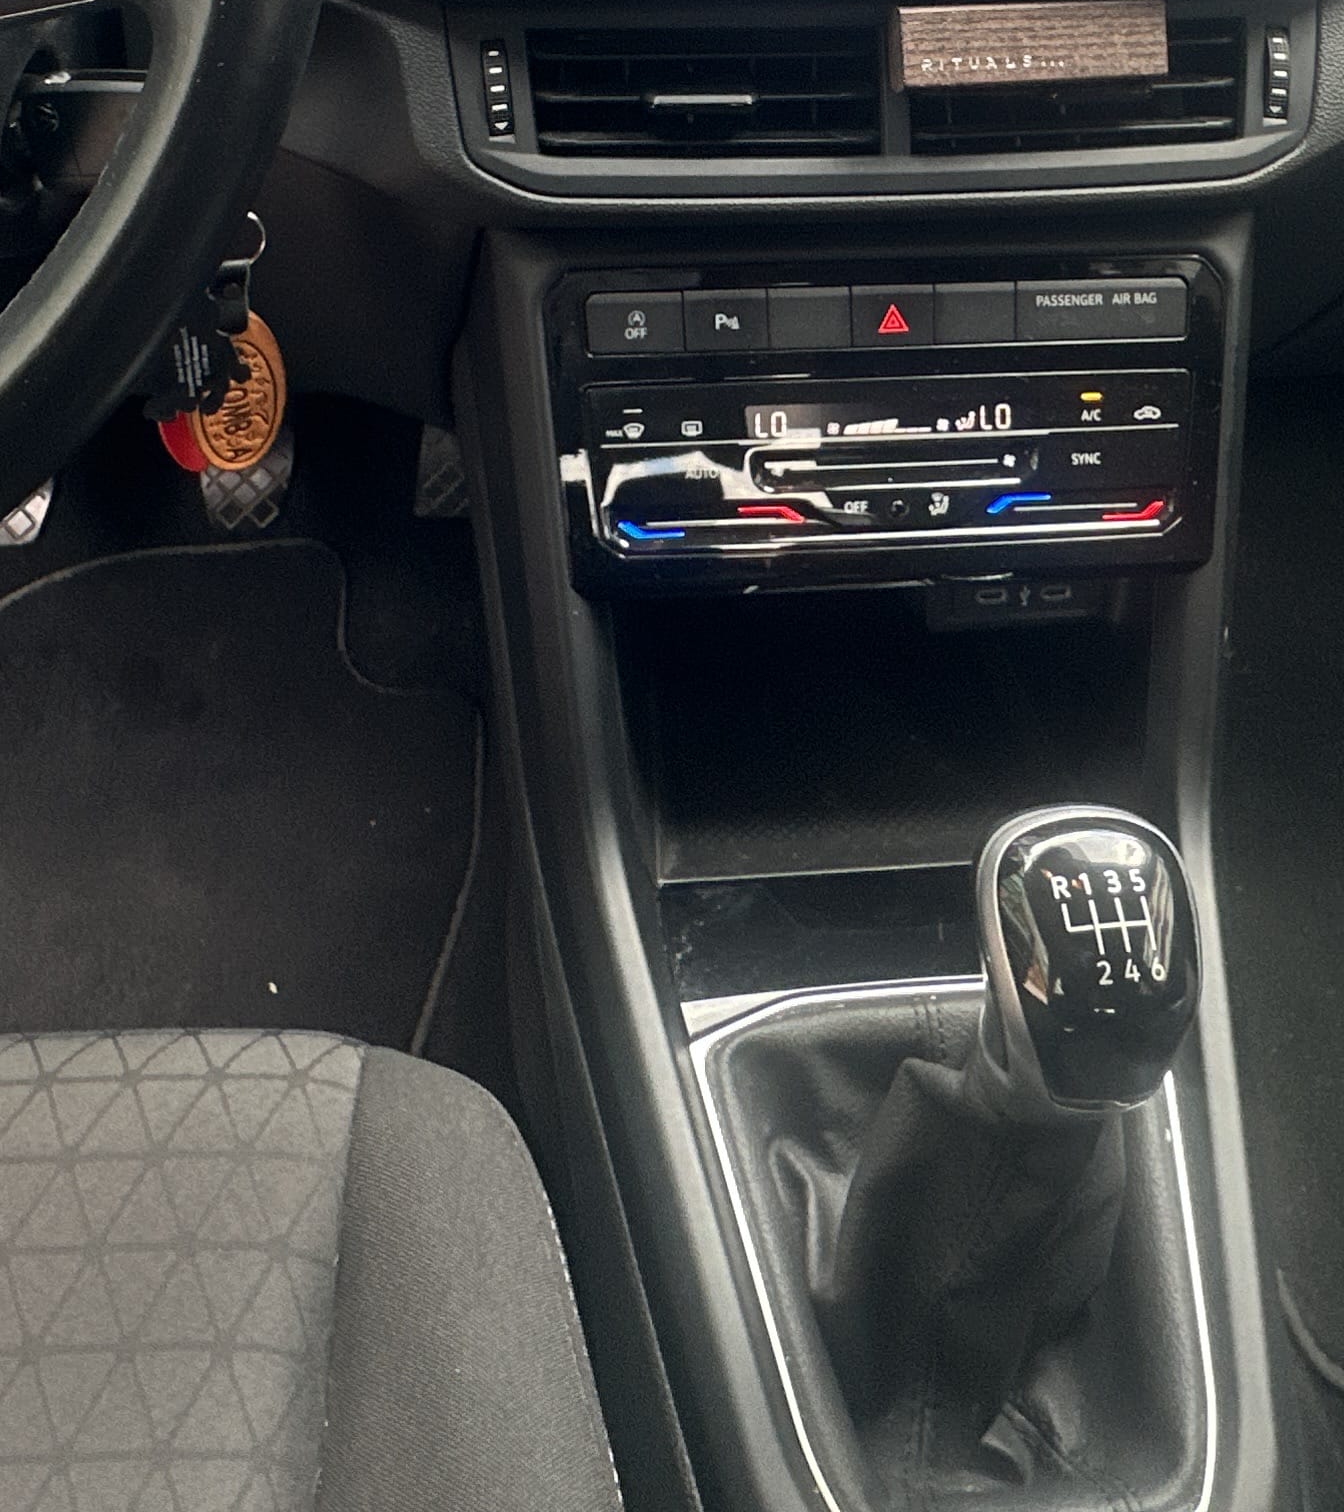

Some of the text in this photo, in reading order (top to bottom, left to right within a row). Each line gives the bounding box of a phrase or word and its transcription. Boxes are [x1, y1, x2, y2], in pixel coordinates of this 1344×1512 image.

[1036, 292, 1157, 307] PASSENGER AIR BAG
[624, 327, 647, 340] OFF
[1080, 409, 1102, 421] A/C
[1071, 452, 1102, 465] SYNC
[685, 469, 720, 480] AUTO
[843, 500, 869, 514] OFF
[1051, 868, 1146, 899] R 1 3 5
[1096, 956, 1166, 986] 2 4 6
